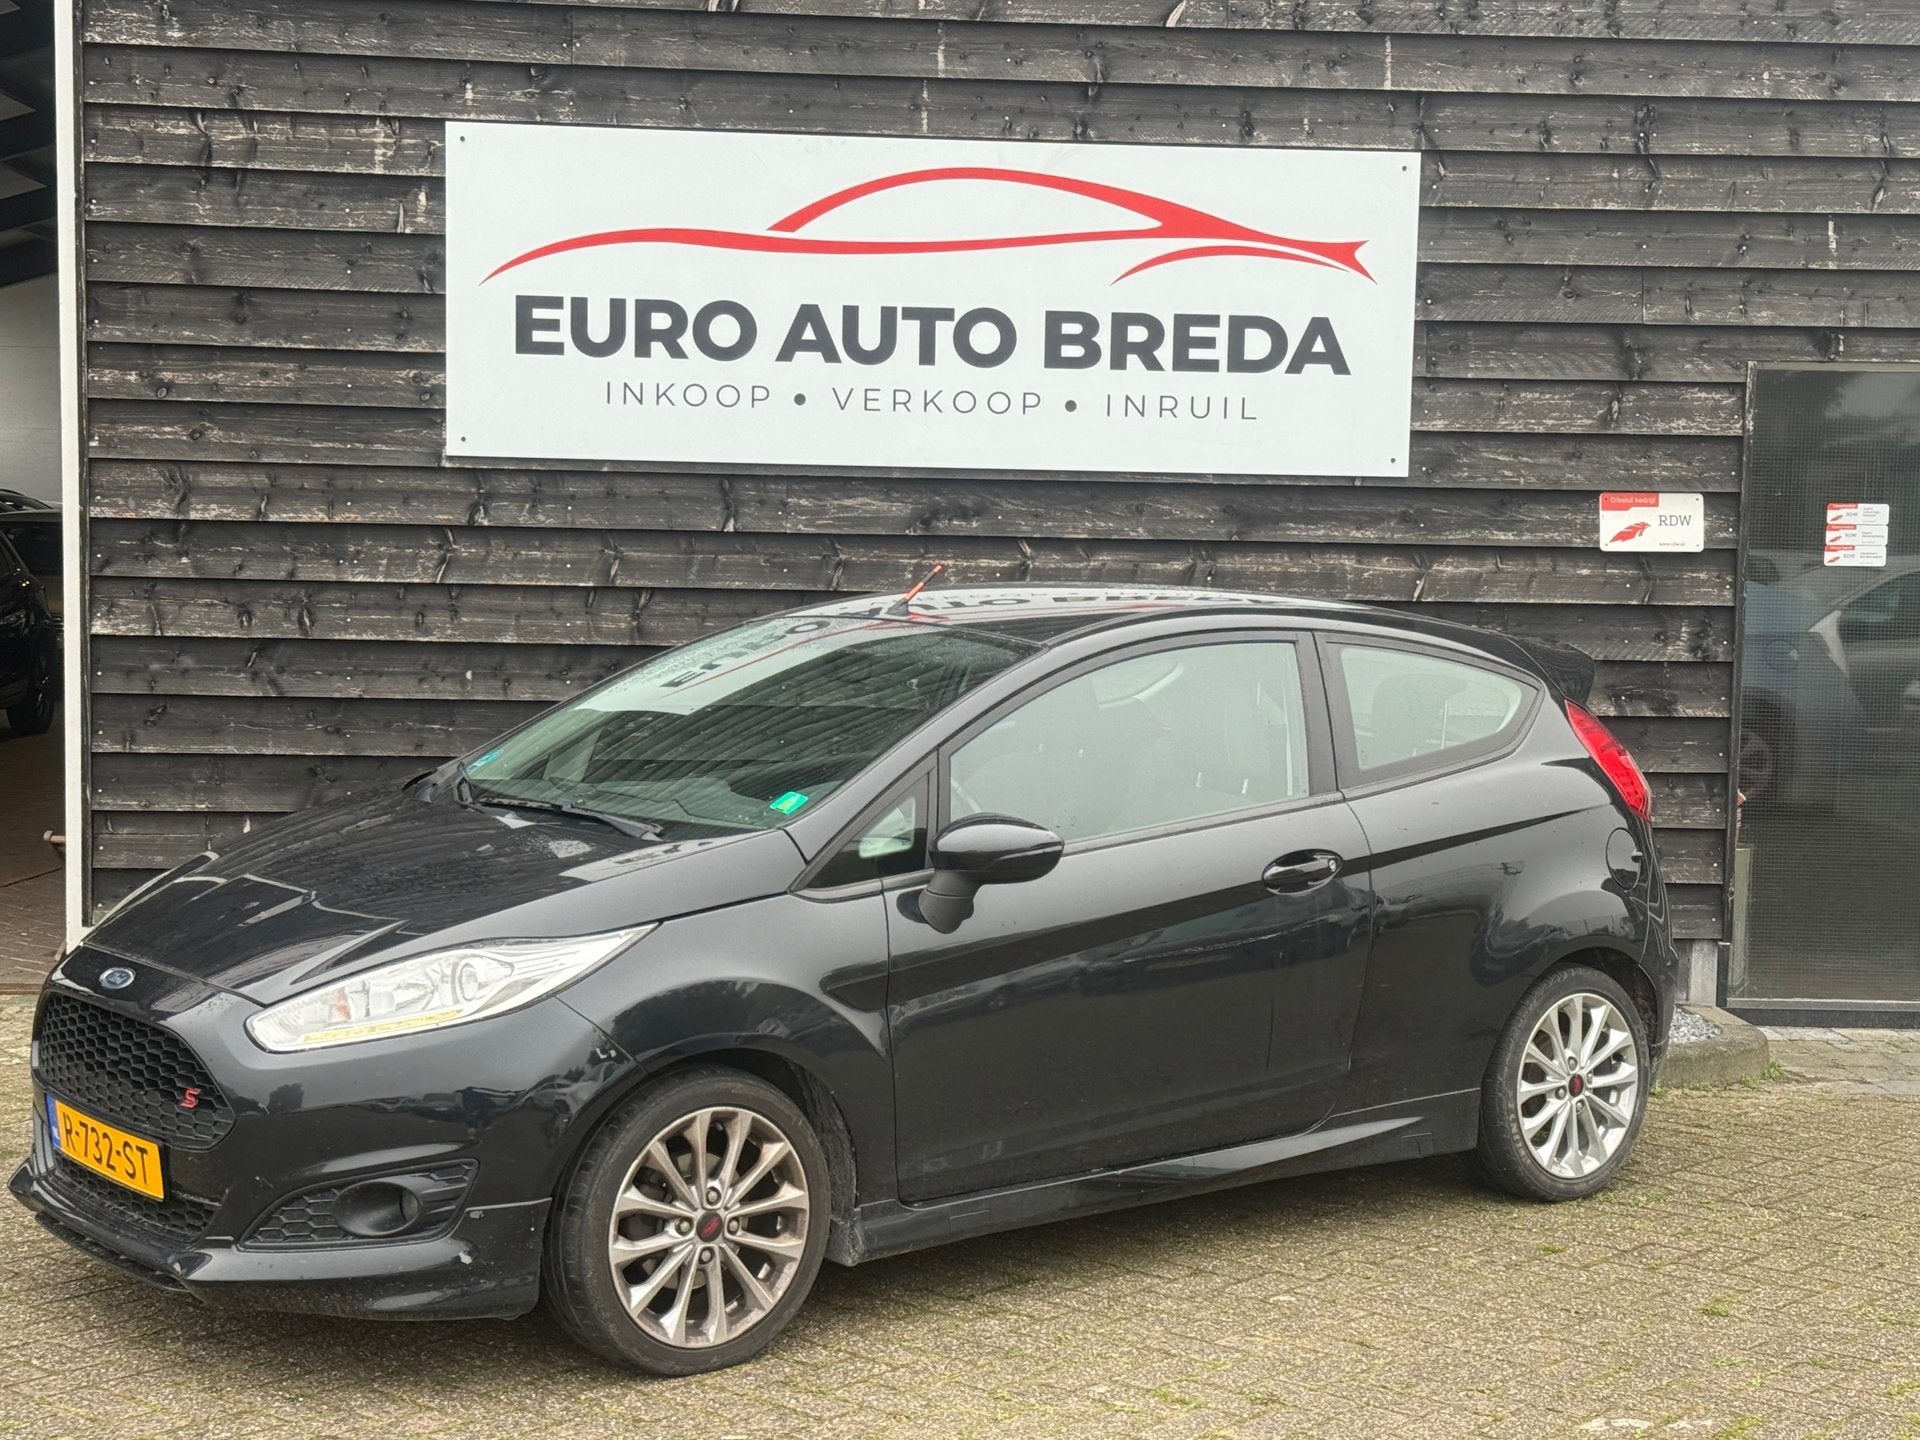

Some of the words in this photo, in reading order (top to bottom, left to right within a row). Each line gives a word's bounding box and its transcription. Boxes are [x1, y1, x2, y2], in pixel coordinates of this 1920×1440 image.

[515, 294, 758, 362] EURO
[774, 303, 1018, 369] AUTO
[1043, 310, 1352, 376] BREDA
[606, 381, 770, 409] INKOOP
[832, 387, 1041, 415] VERKOOP
[1106, 394, 1258, 420] INRUIL
[1658, 514, 1692, 527] RDW
[62, 1111, 149, 1186] R-732-ST
